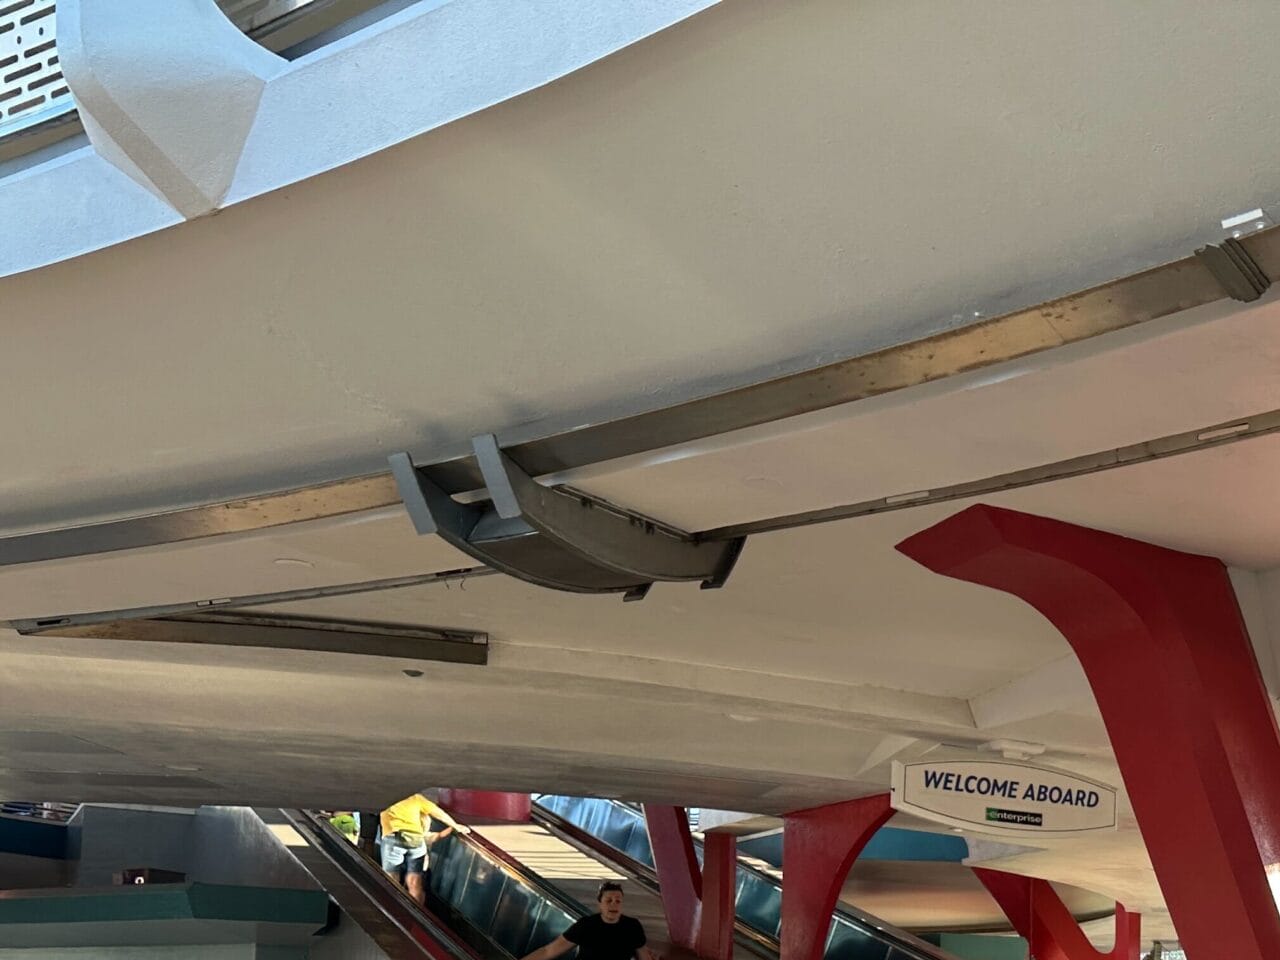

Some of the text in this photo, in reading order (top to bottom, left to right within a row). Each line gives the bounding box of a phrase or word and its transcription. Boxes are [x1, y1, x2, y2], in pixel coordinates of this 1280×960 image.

[923, 770, 1100, 808] WELCOME ABOARD
[989, 809, 1042, 824] enterprise
